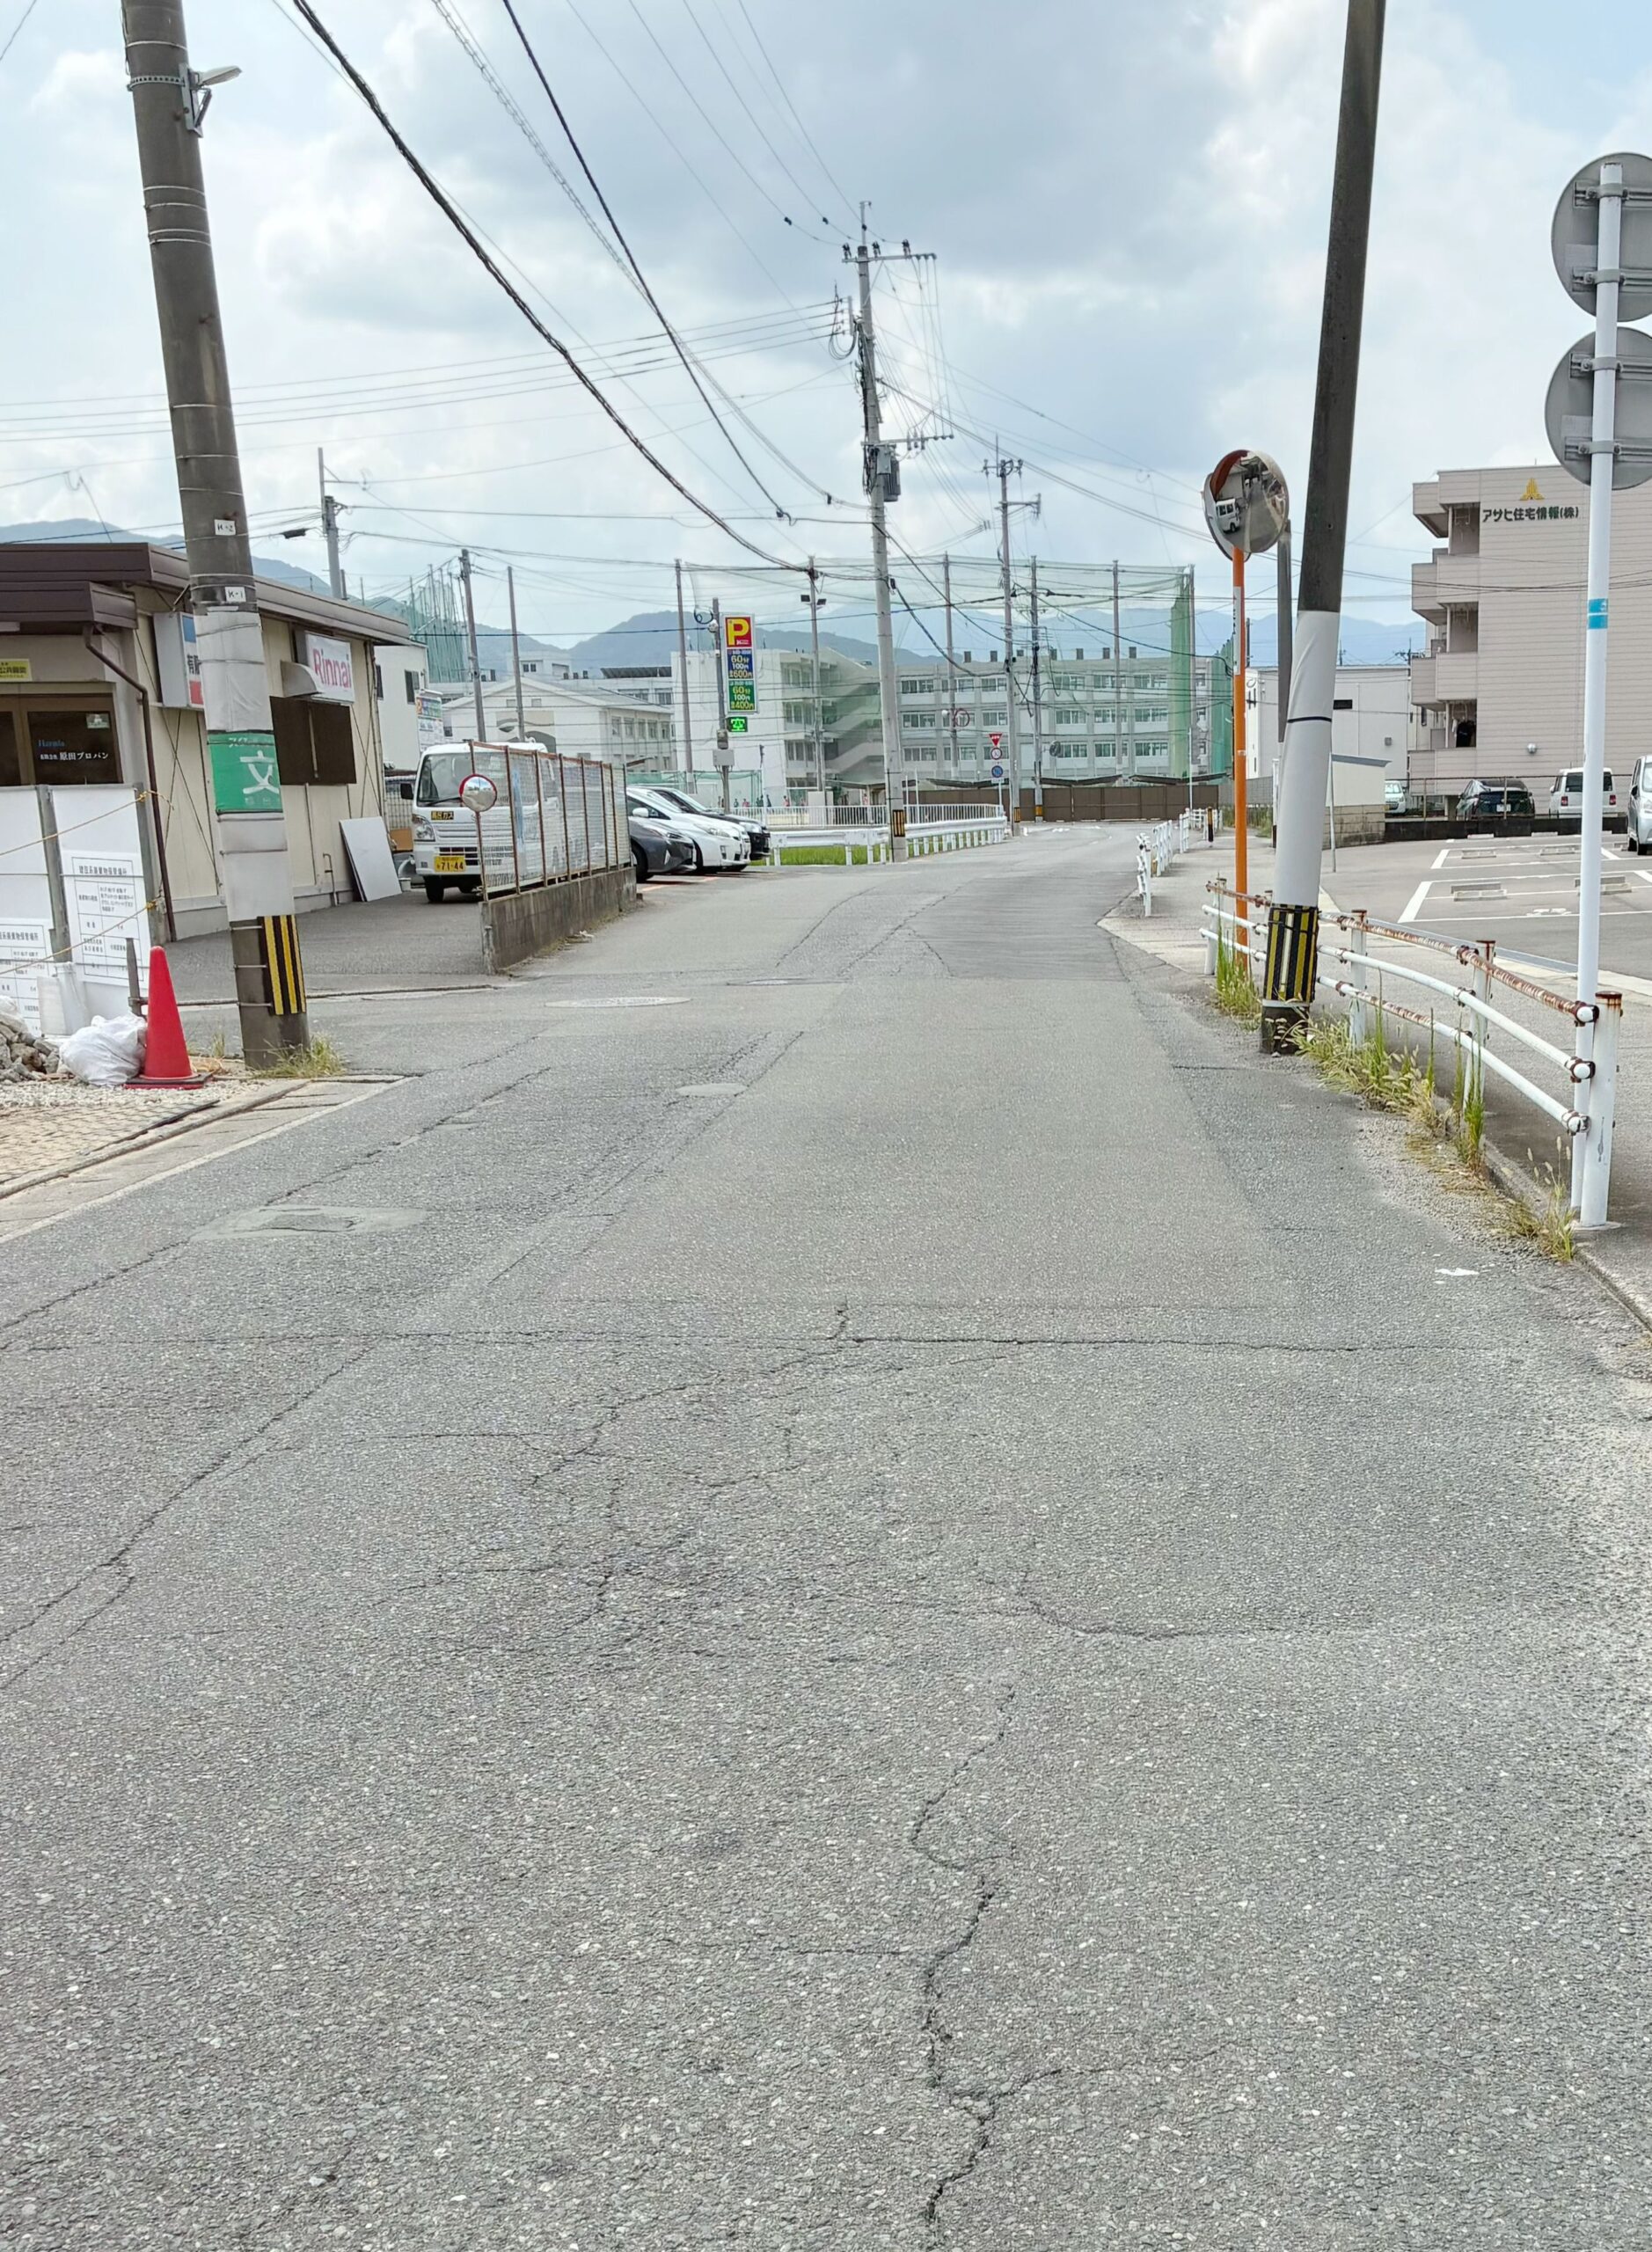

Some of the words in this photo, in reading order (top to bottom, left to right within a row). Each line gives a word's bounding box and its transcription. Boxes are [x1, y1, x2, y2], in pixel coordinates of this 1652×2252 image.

[1482, 506, 1579, 523] アサヒ住宅情報(株)
[727, 618, 749, 646] P
[312, 647, 352, 689] Rinnai
[239, 749, 280, 794] 文
